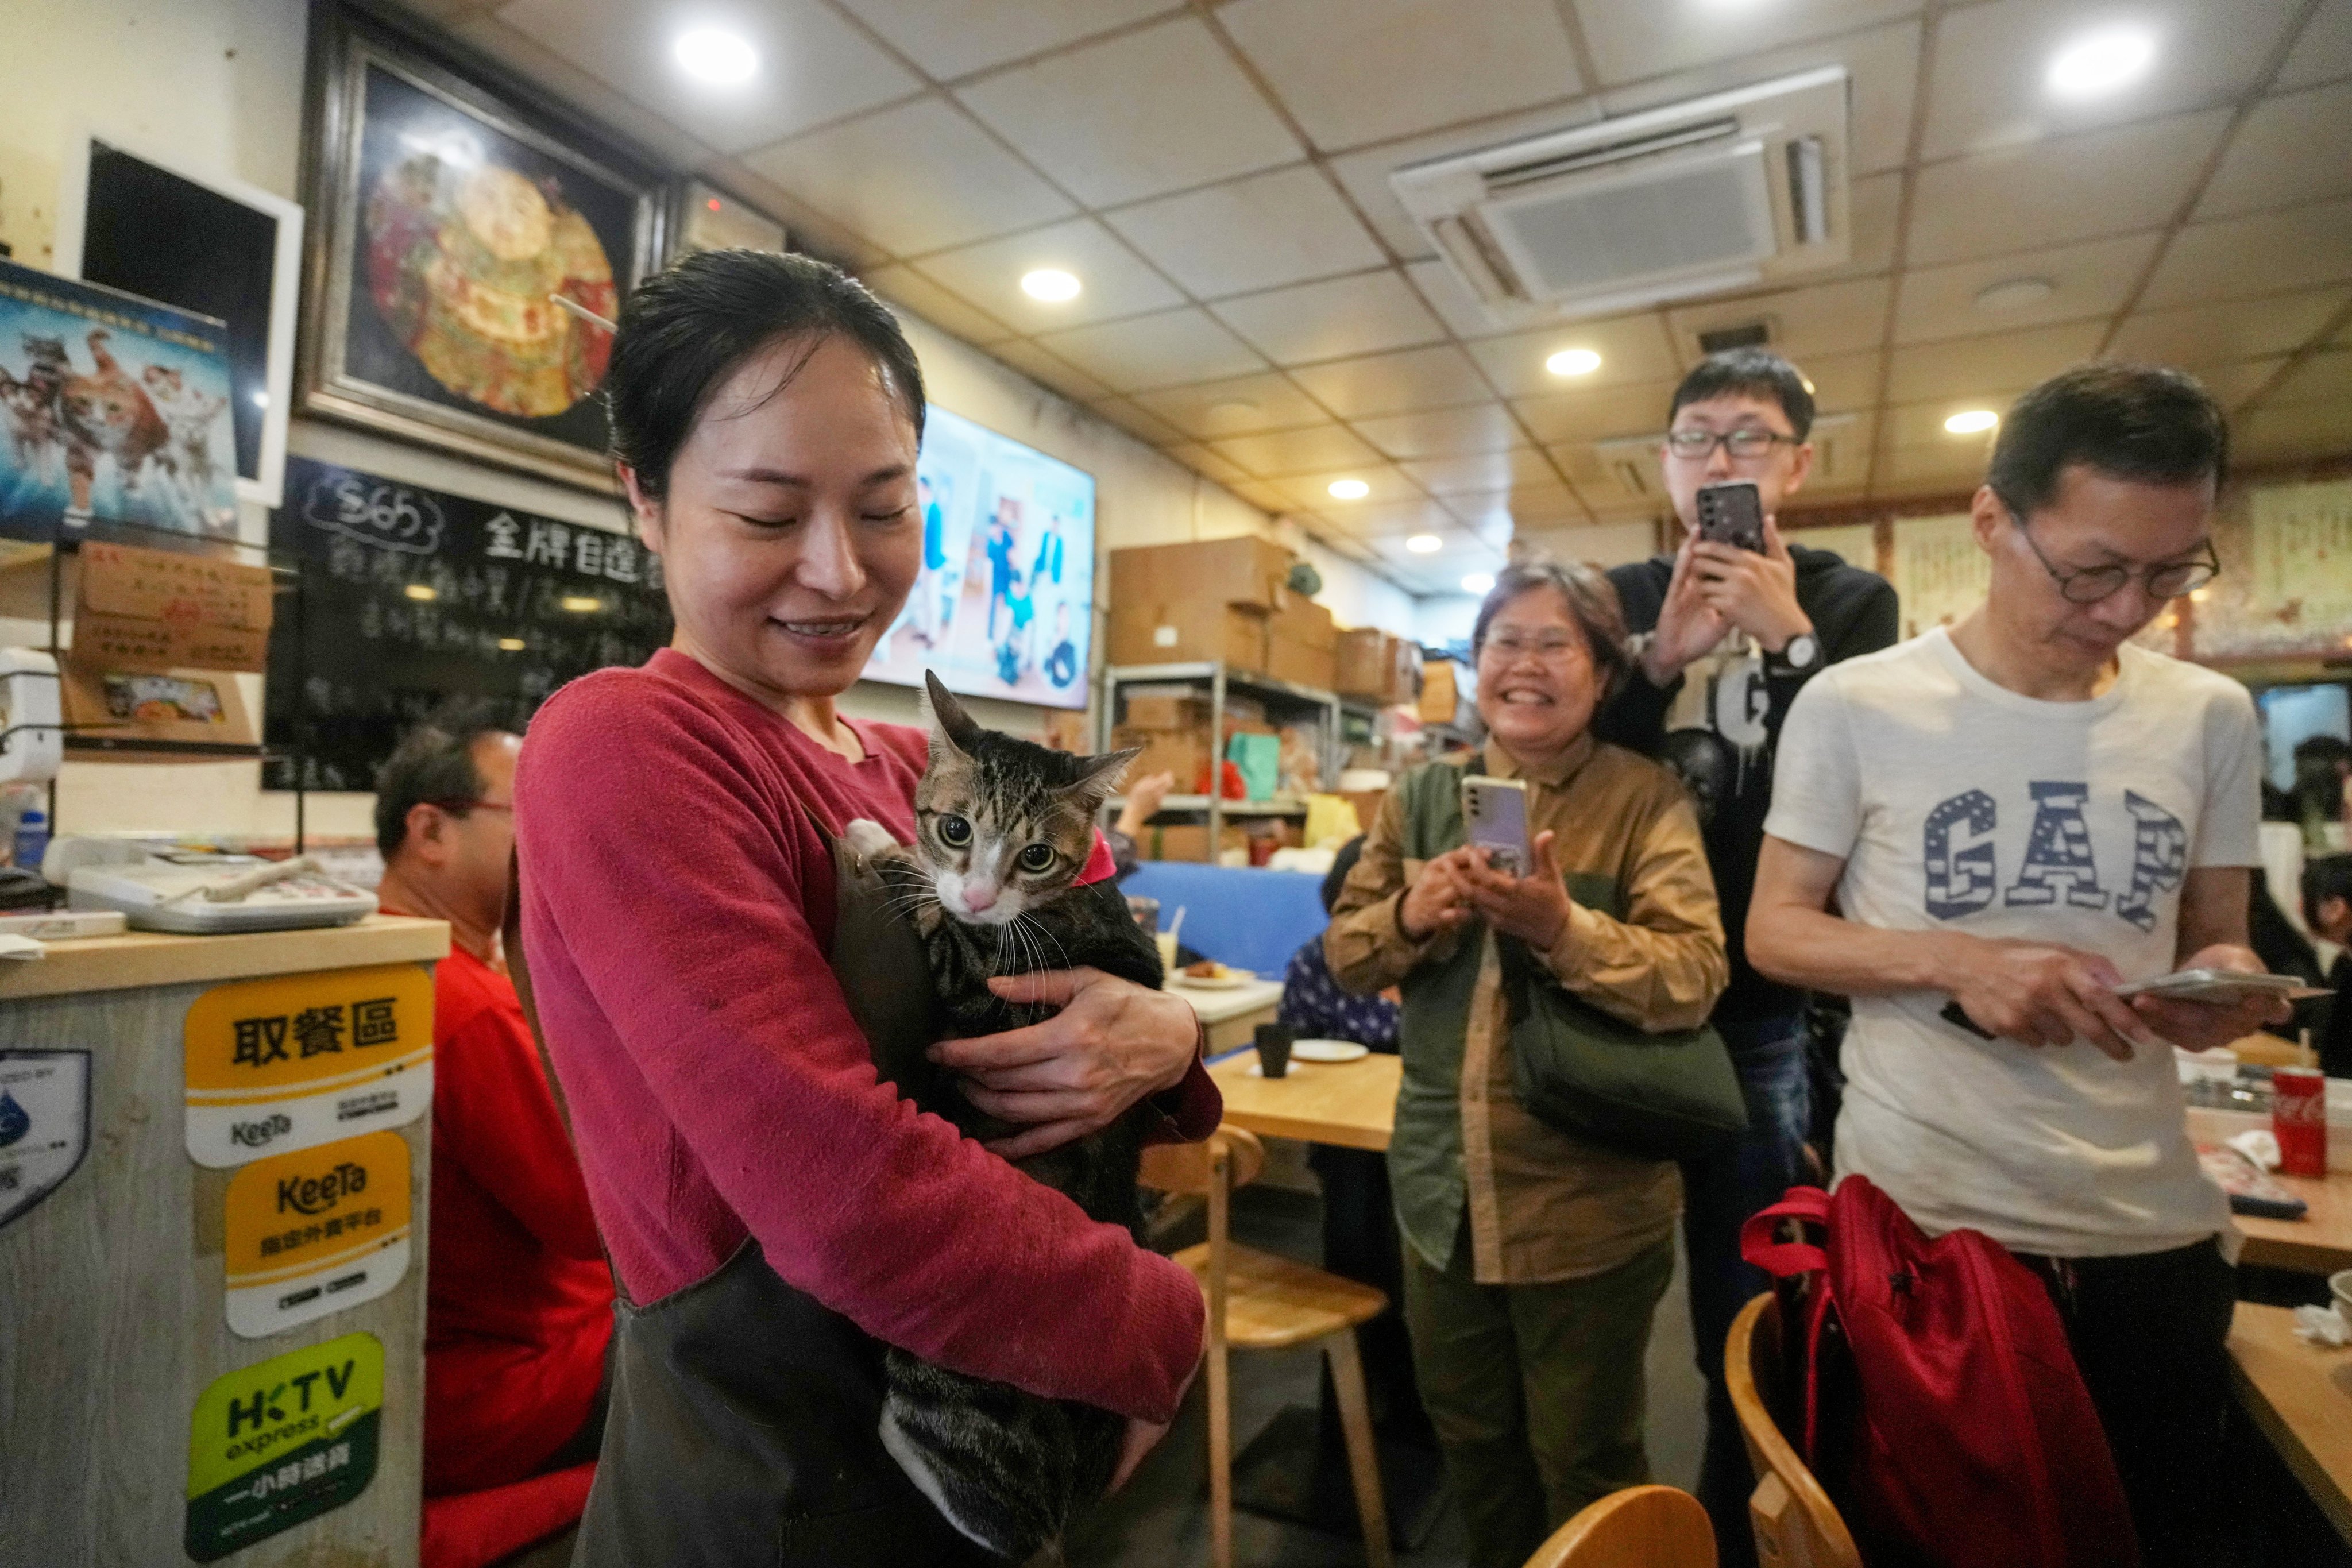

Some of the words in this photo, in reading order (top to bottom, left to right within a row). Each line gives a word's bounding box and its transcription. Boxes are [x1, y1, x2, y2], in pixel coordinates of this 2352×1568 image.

[1923, 779, 2191, 933] GAP
[233, 996, 399, 1067] 取餐區
[230, 1113, 292, 1147] KeeTa
[277, 1161, 368, 1215] KeeTa
[227, 1359, 355, 1438] HKTV
[226, 1414, 320, 1461] express
